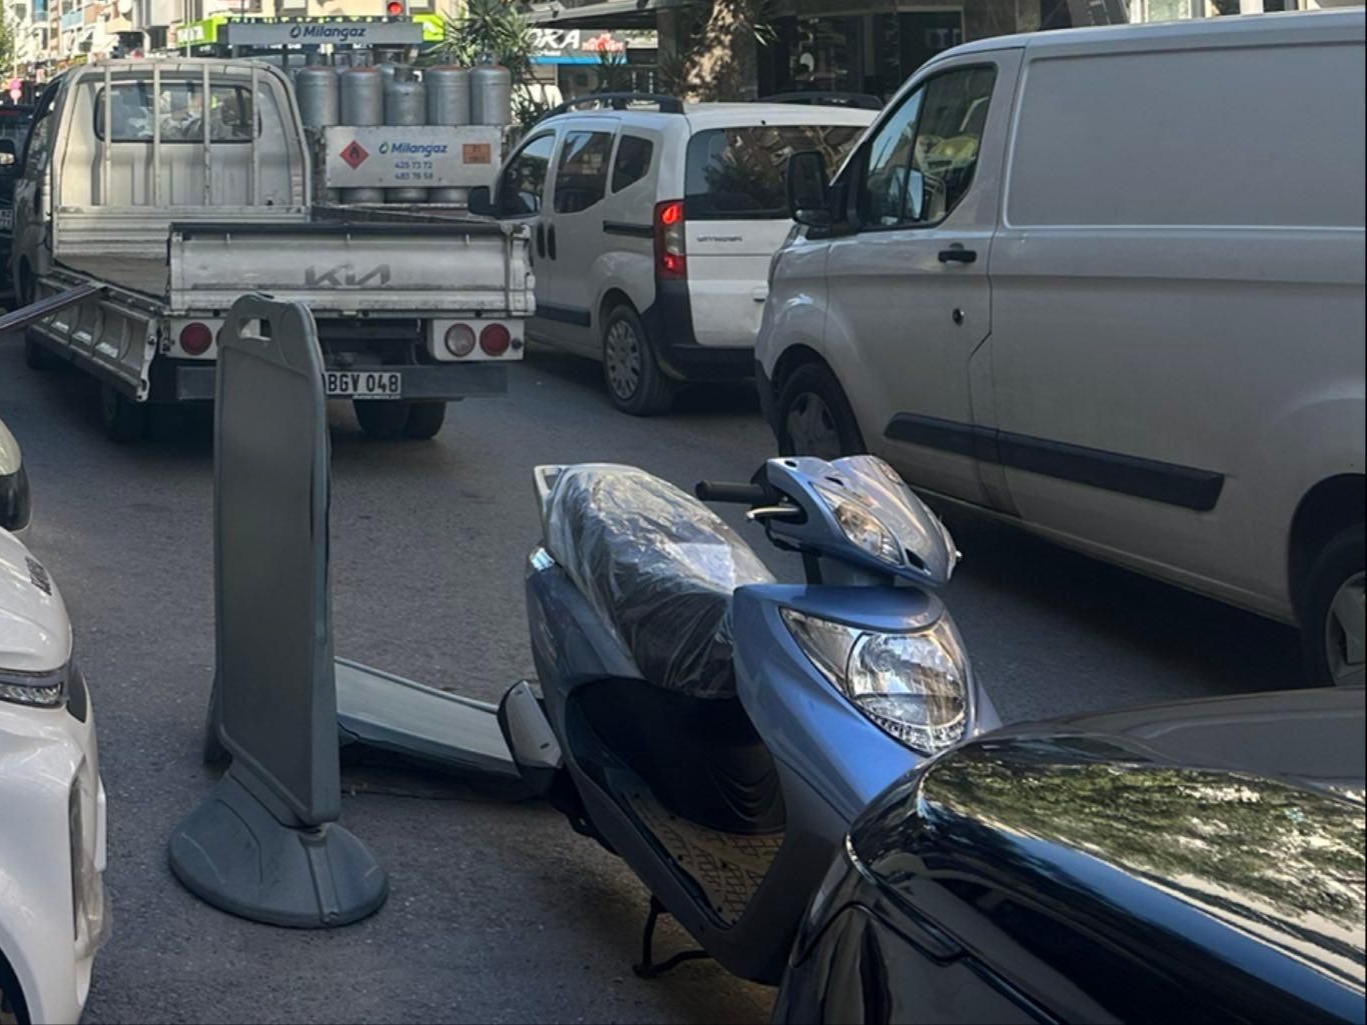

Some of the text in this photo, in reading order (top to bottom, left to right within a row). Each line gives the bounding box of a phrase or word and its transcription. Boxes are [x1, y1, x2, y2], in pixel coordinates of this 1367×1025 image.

[302, 26, 366, 42] Milangaz
[391, 142, 449, 157] Milangaz
[305, 264, 391, 286] KIA
[328, 374, 399, 393] BGV 048
